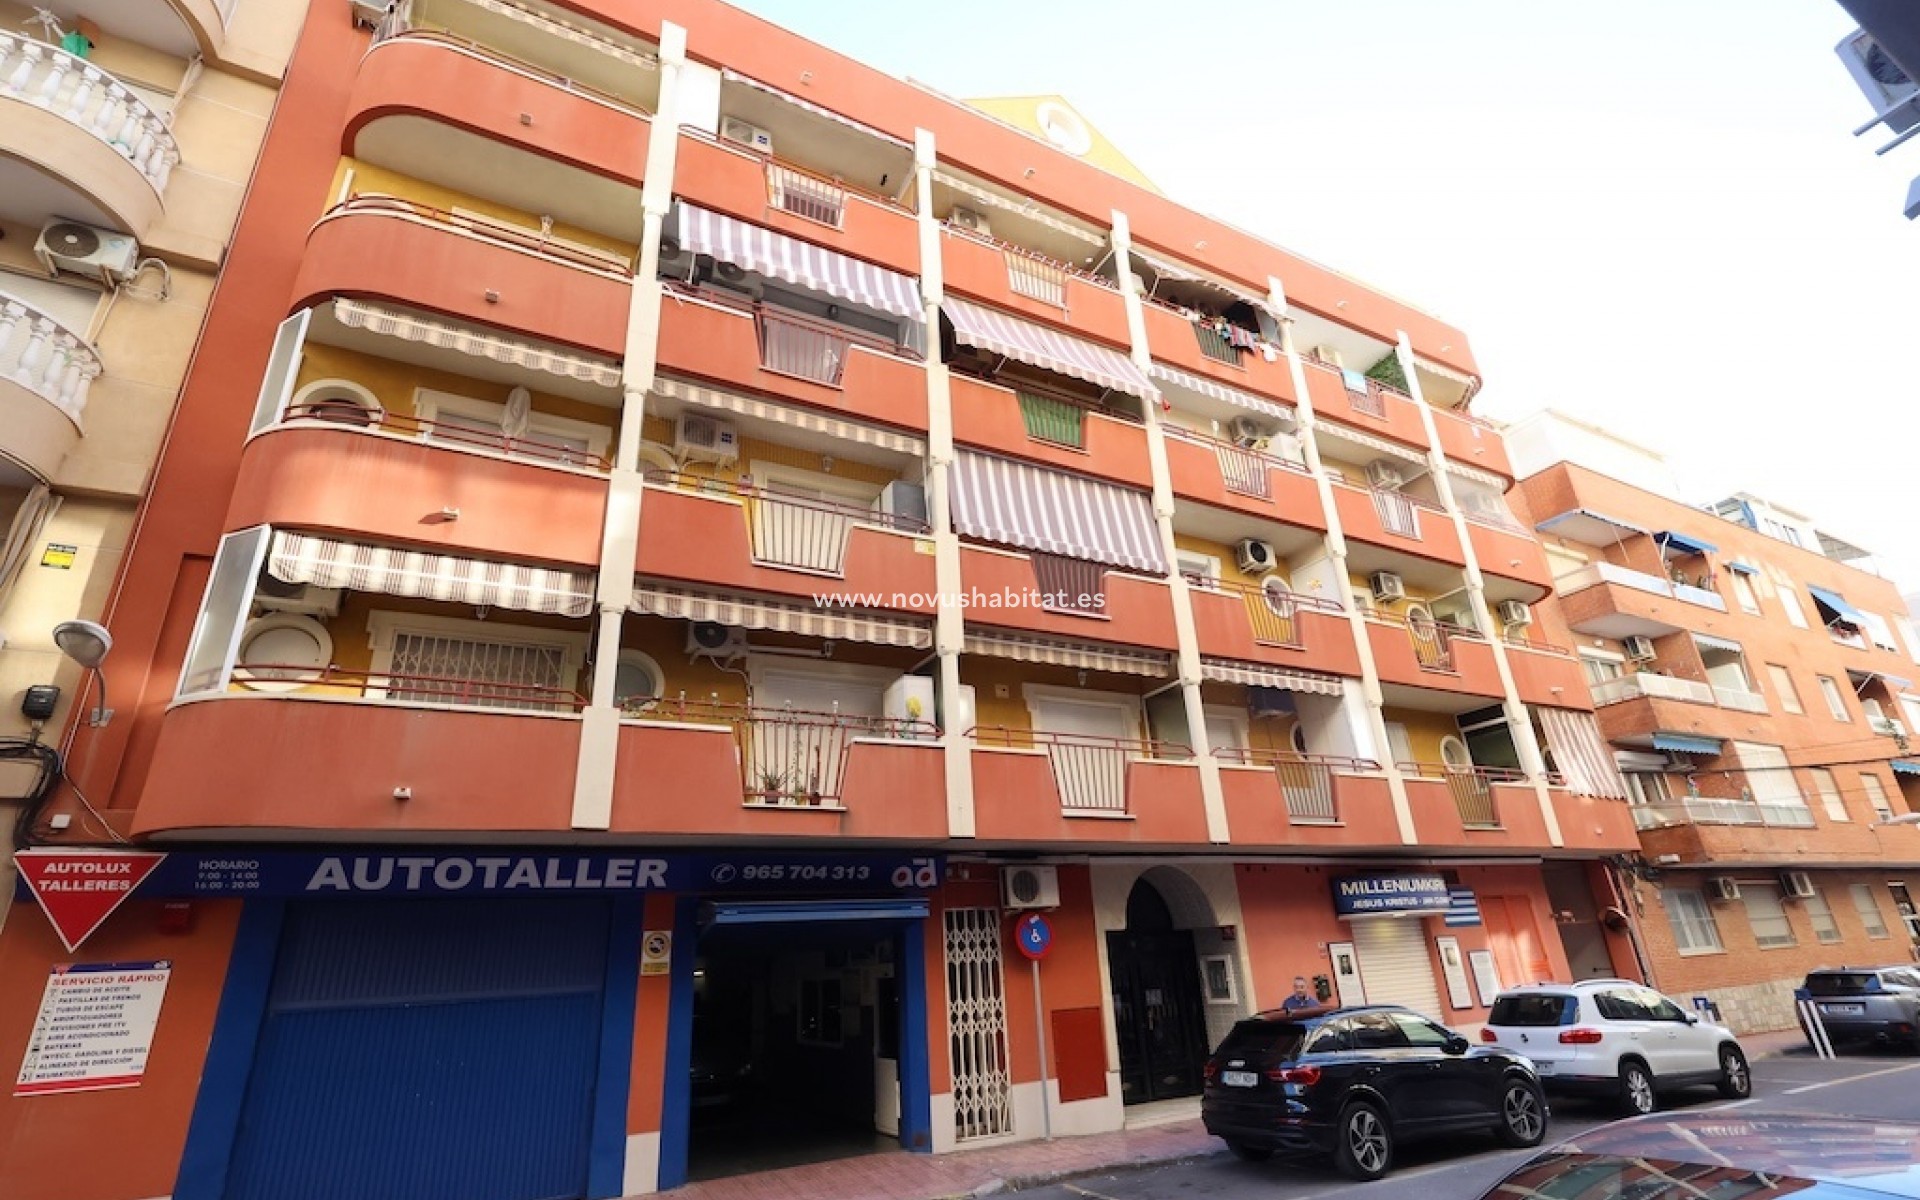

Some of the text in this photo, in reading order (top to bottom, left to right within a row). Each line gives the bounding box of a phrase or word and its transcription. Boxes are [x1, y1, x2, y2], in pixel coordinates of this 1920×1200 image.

[43, 862, 132, 874] AUTOLUX
[198, 860, 260, 870] HORARIO
[305, 857, 669, 890] AUTOTALLER
[742, 864, 870, 879] 965 704 313
[38, 880, 131, 891] TALLERES
[52, 976, 115, 986] SERVICIO
